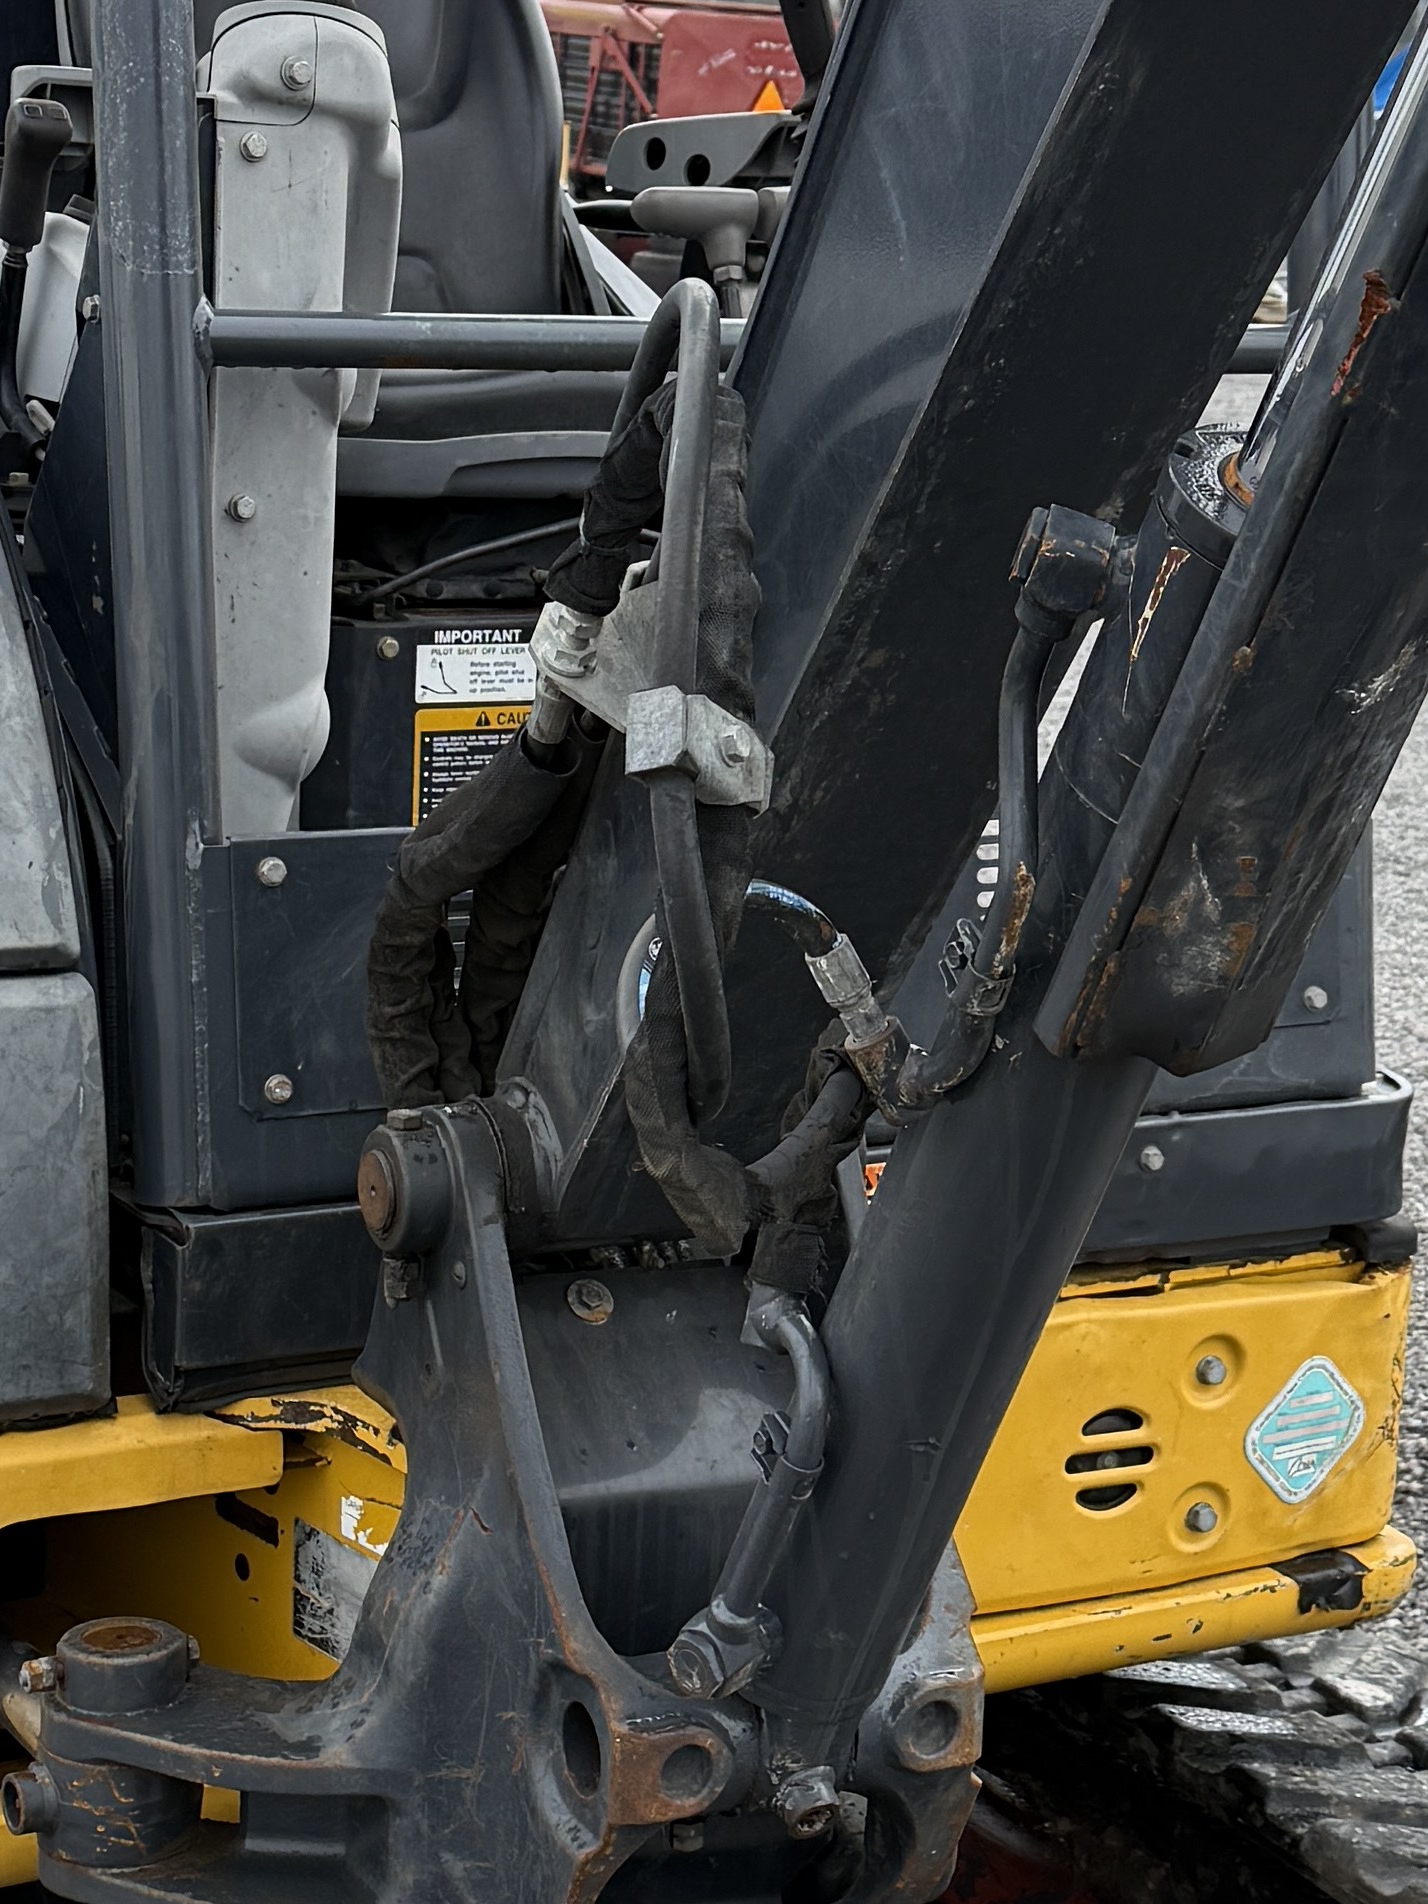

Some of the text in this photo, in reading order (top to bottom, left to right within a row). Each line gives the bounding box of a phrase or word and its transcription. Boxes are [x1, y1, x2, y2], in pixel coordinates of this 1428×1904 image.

[434, 628, 523, 644] IMPORTANT
[431, 646, 526, 656] PILOT SHUT OFF LEVER
